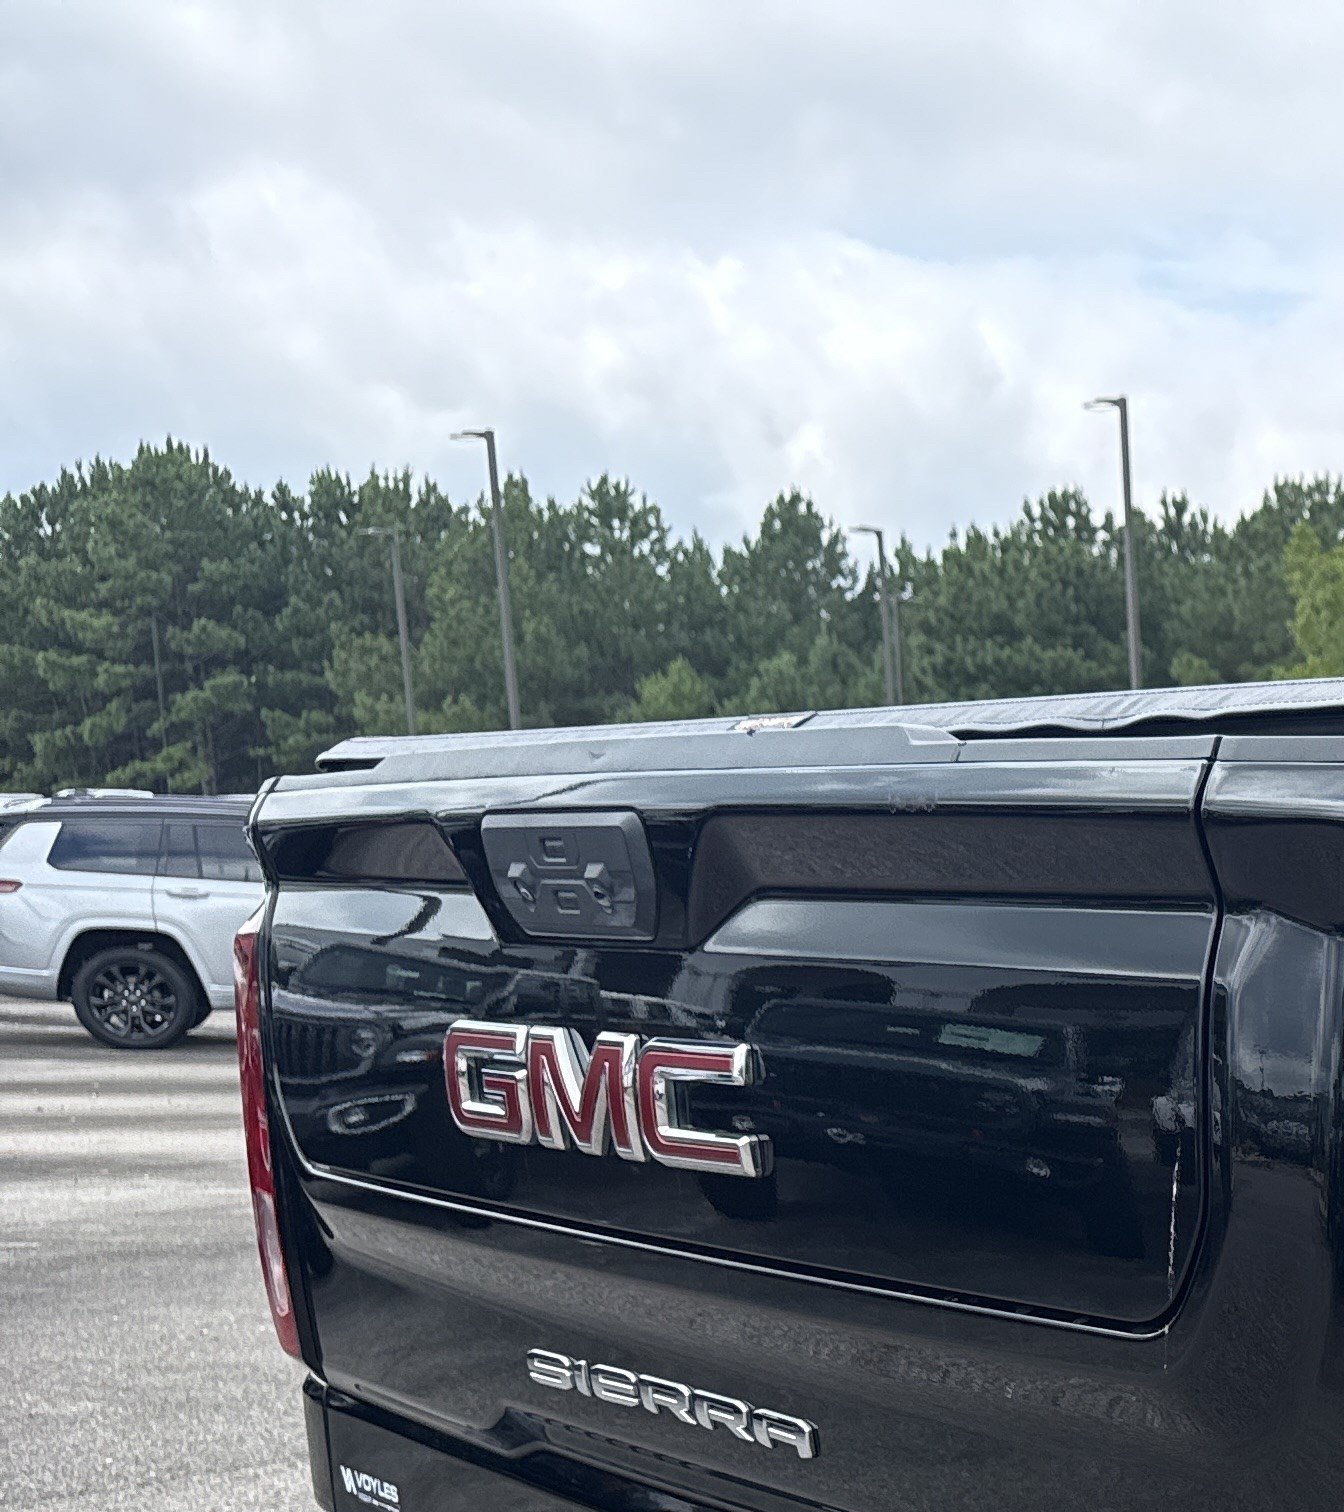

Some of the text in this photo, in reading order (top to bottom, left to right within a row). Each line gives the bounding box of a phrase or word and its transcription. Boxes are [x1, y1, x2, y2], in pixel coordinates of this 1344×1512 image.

[443, 1019, 774, 1179] GMC
[526, 1347, 819, 1459] SIERRA
[354, 1469, 399, 1504] VOYLES
